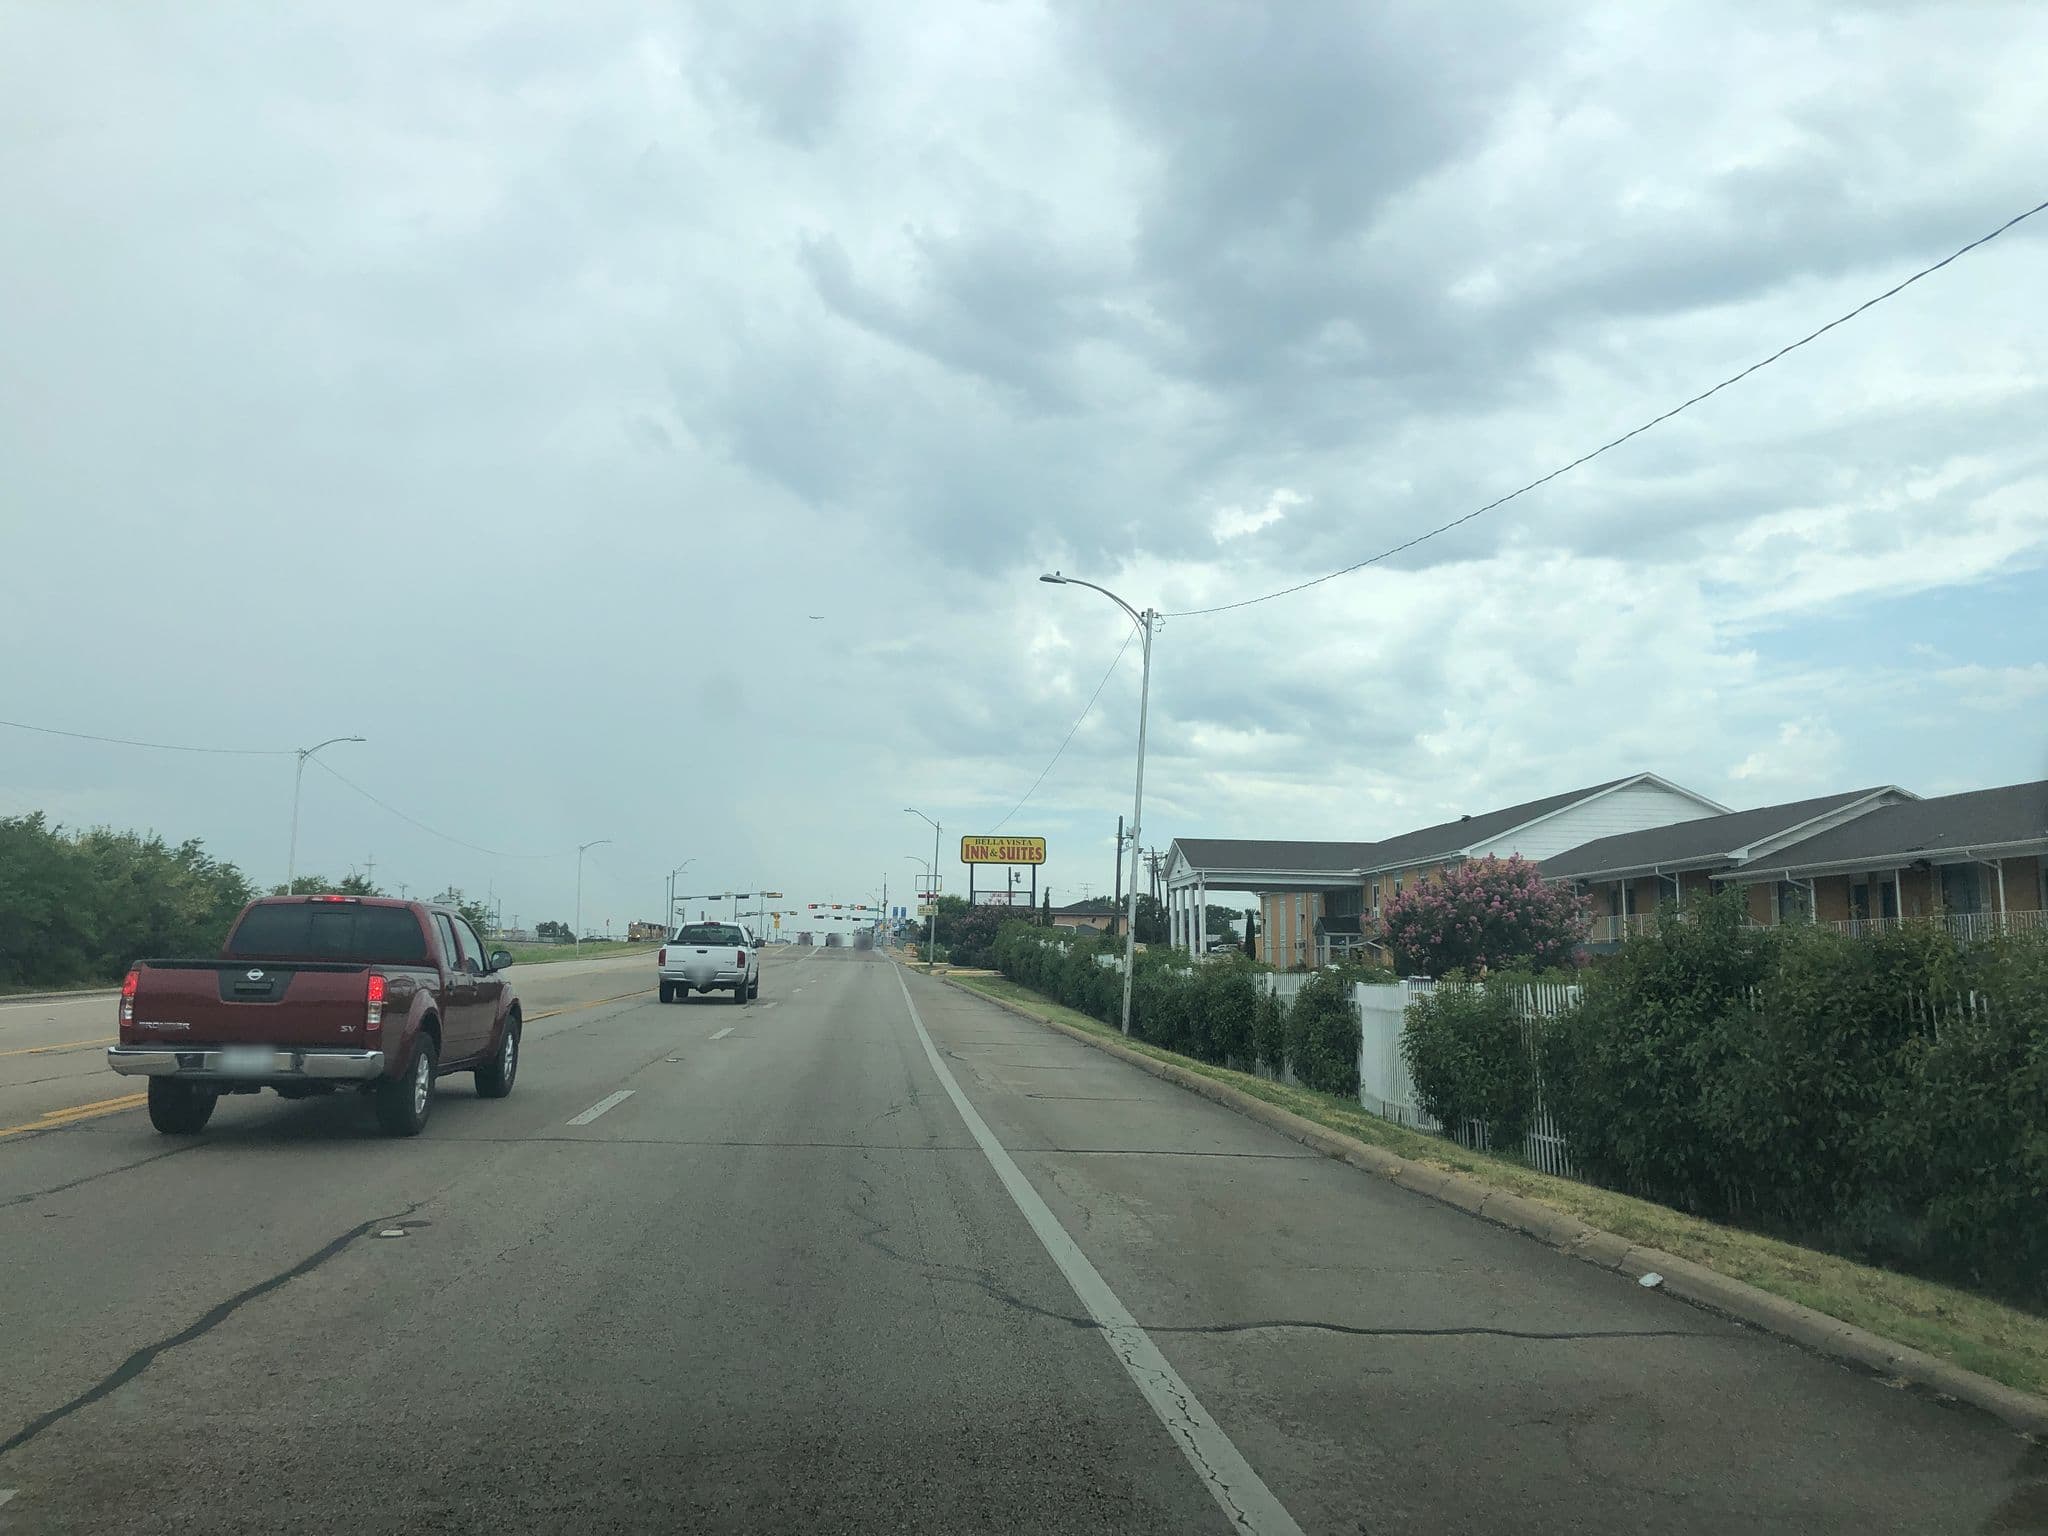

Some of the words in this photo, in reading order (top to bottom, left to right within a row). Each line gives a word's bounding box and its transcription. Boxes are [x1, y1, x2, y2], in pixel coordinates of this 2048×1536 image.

[975, 838, 1003, 846] BELLA
[965, 844, 989, 860] INN
[990, 848, 998, 857] &
[999, 846, 1042, 861] SUITES
[340, 1025, 357, 1033] SV
